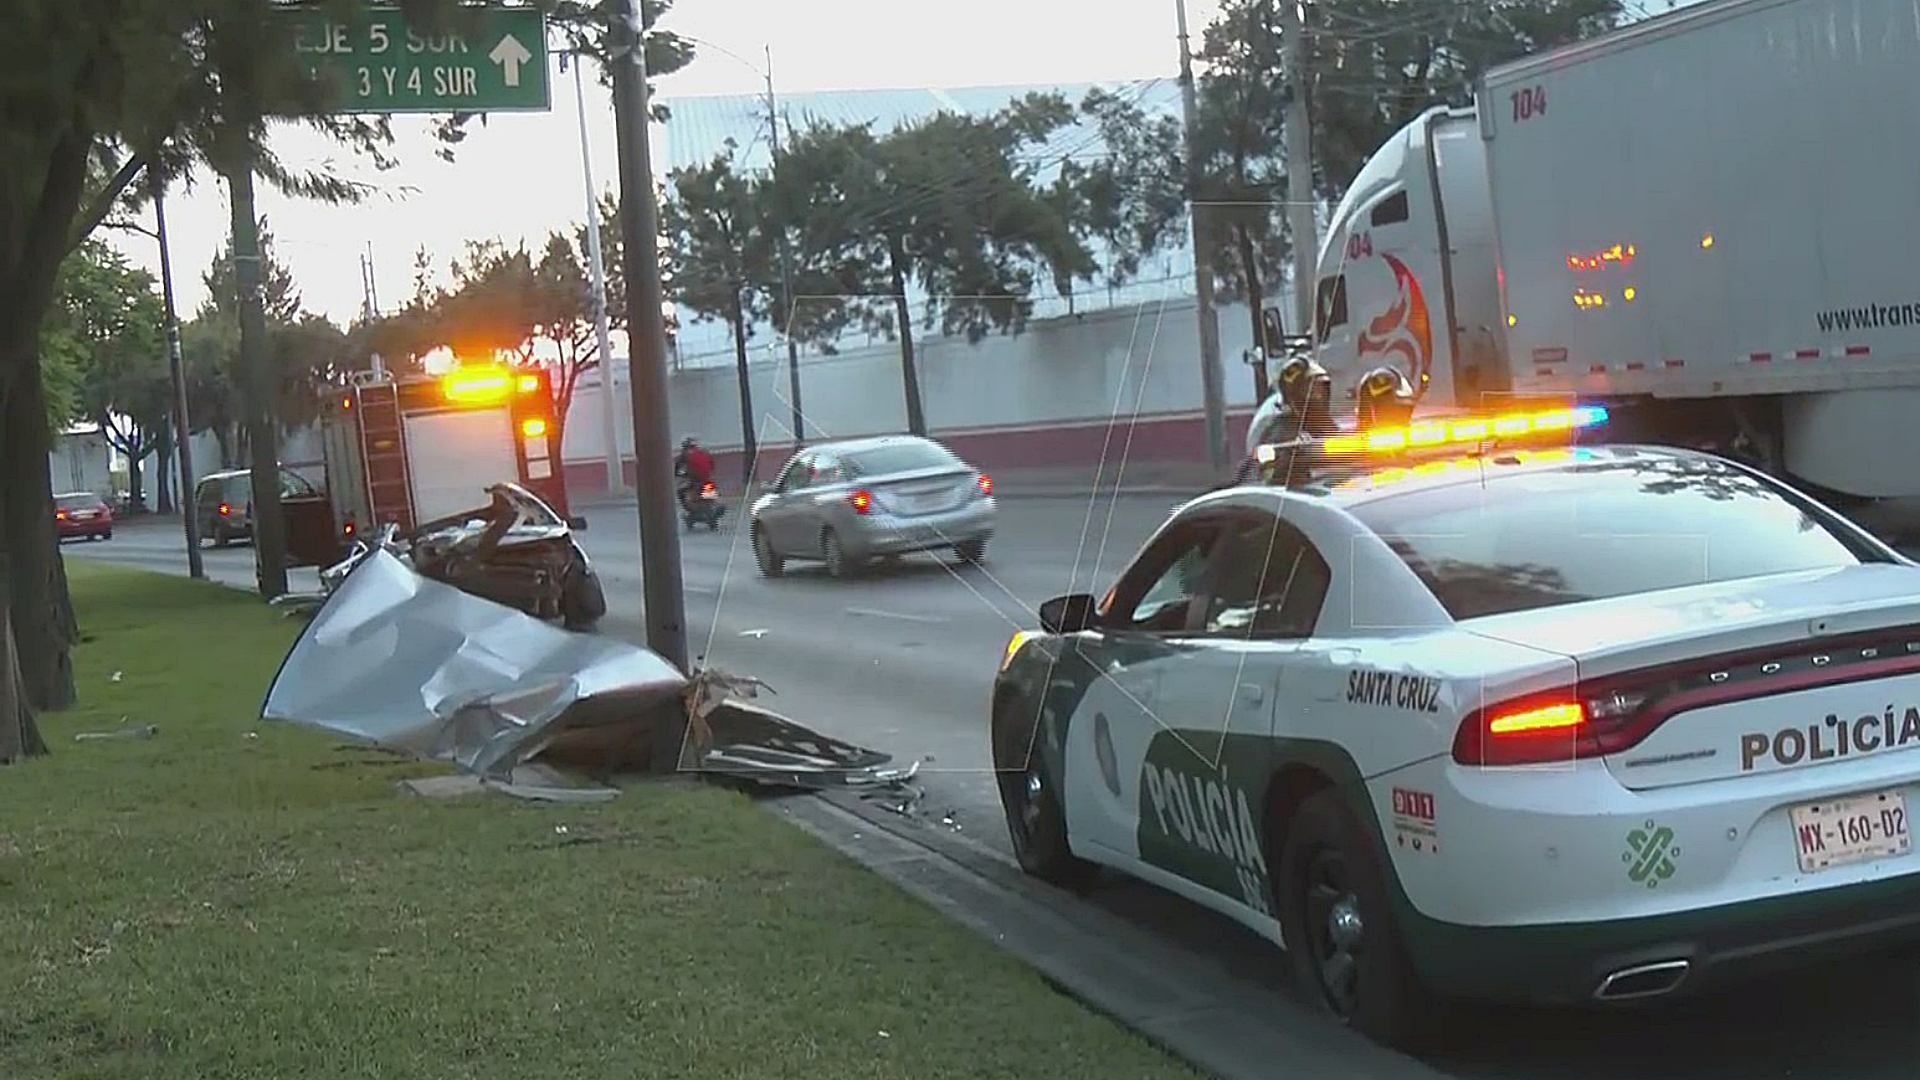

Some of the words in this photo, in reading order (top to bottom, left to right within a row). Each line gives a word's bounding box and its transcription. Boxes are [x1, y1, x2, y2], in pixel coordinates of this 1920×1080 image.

[369, 23, 389, 53] 5
[357, 66, 371, 96] 3
[382, 66, 396, 96] Y
[407, 66, 422, 96] 4
[433, 66, 477, 96] SUR
[1510, 85, 1547, 122] 104
[1346, 669, 1392, 706] SANTA
[1397, 675, 1441, 713] CRUZ
[1741, 703, 1920, 771] POLICÍA
[1394, 791, 1432, 817] 911
[1799, 807, 1906, 854] MX-160-D2
